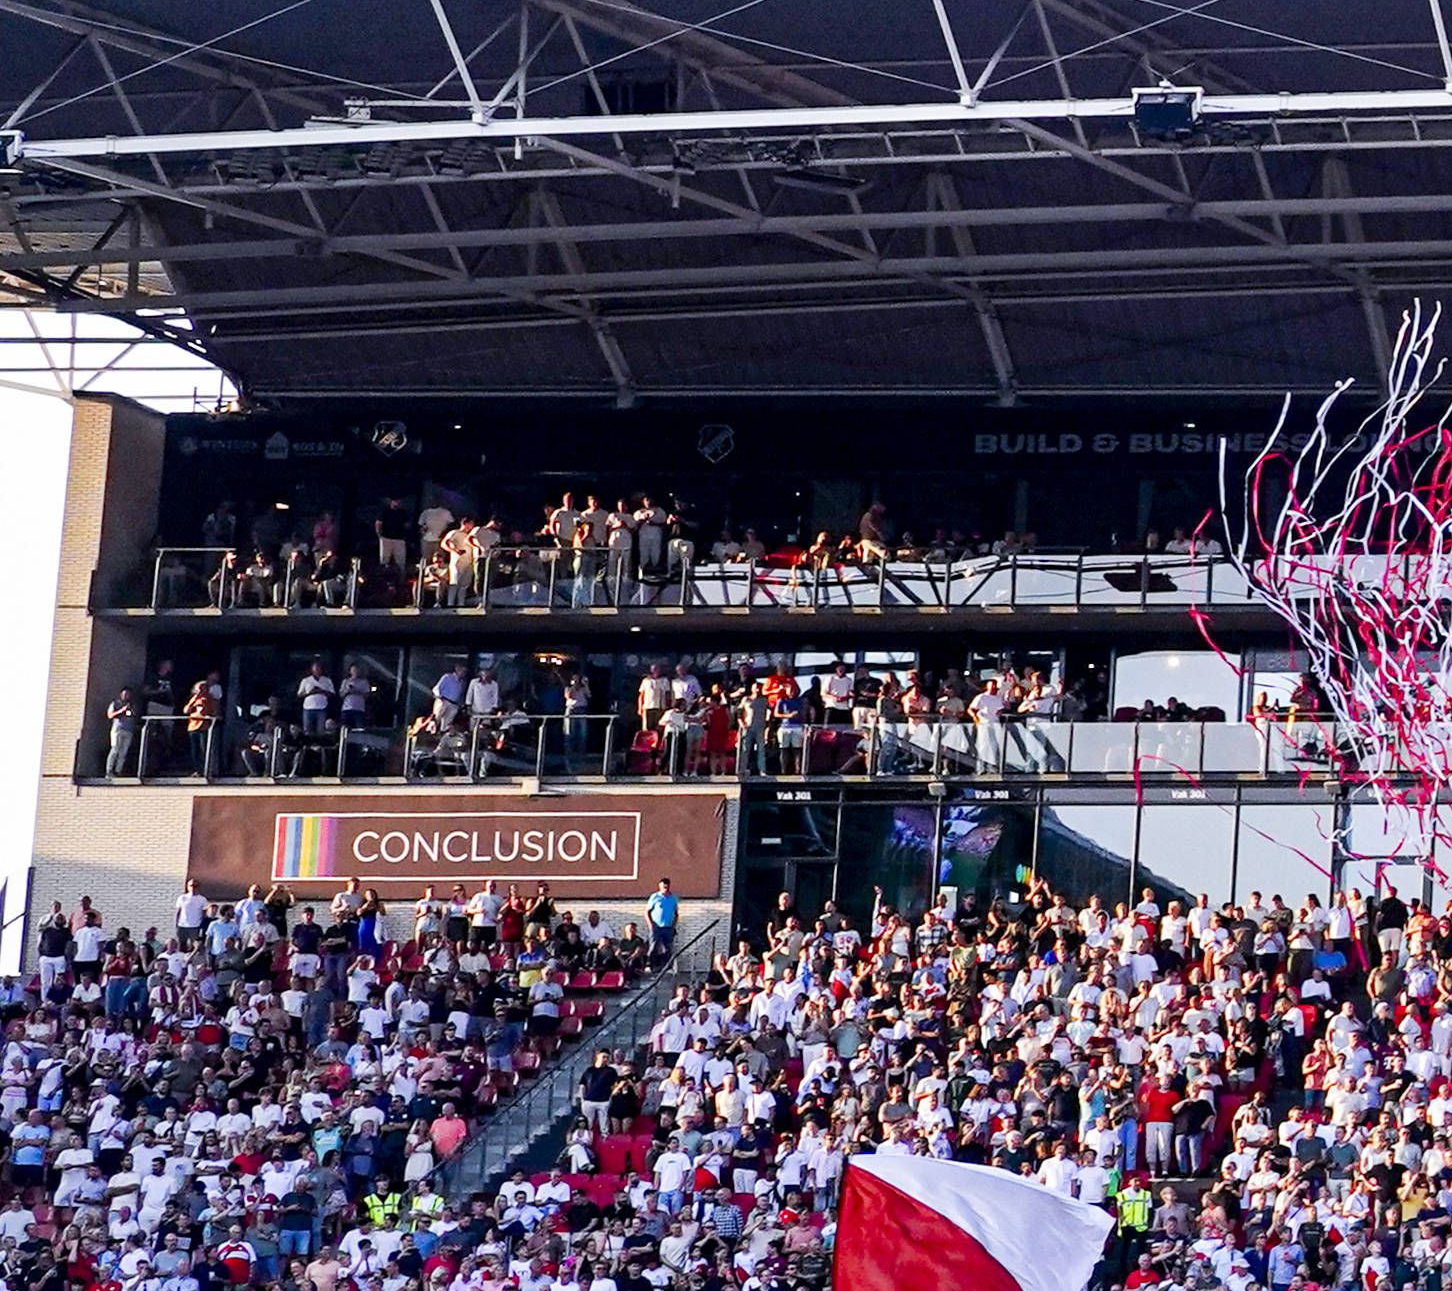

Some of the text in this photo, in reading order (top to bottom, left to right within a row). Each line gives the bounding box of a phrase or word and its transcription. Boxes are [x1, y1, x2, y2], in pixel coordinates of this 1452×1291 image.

[974, 433, 1083, 454] BUILD
[1092, 433, 1120, 454] &
[776, 791, 793, 800] Vak
[975, 790, 991, 799] Vak
[353, 829, 618, 862] CONCLUSION
